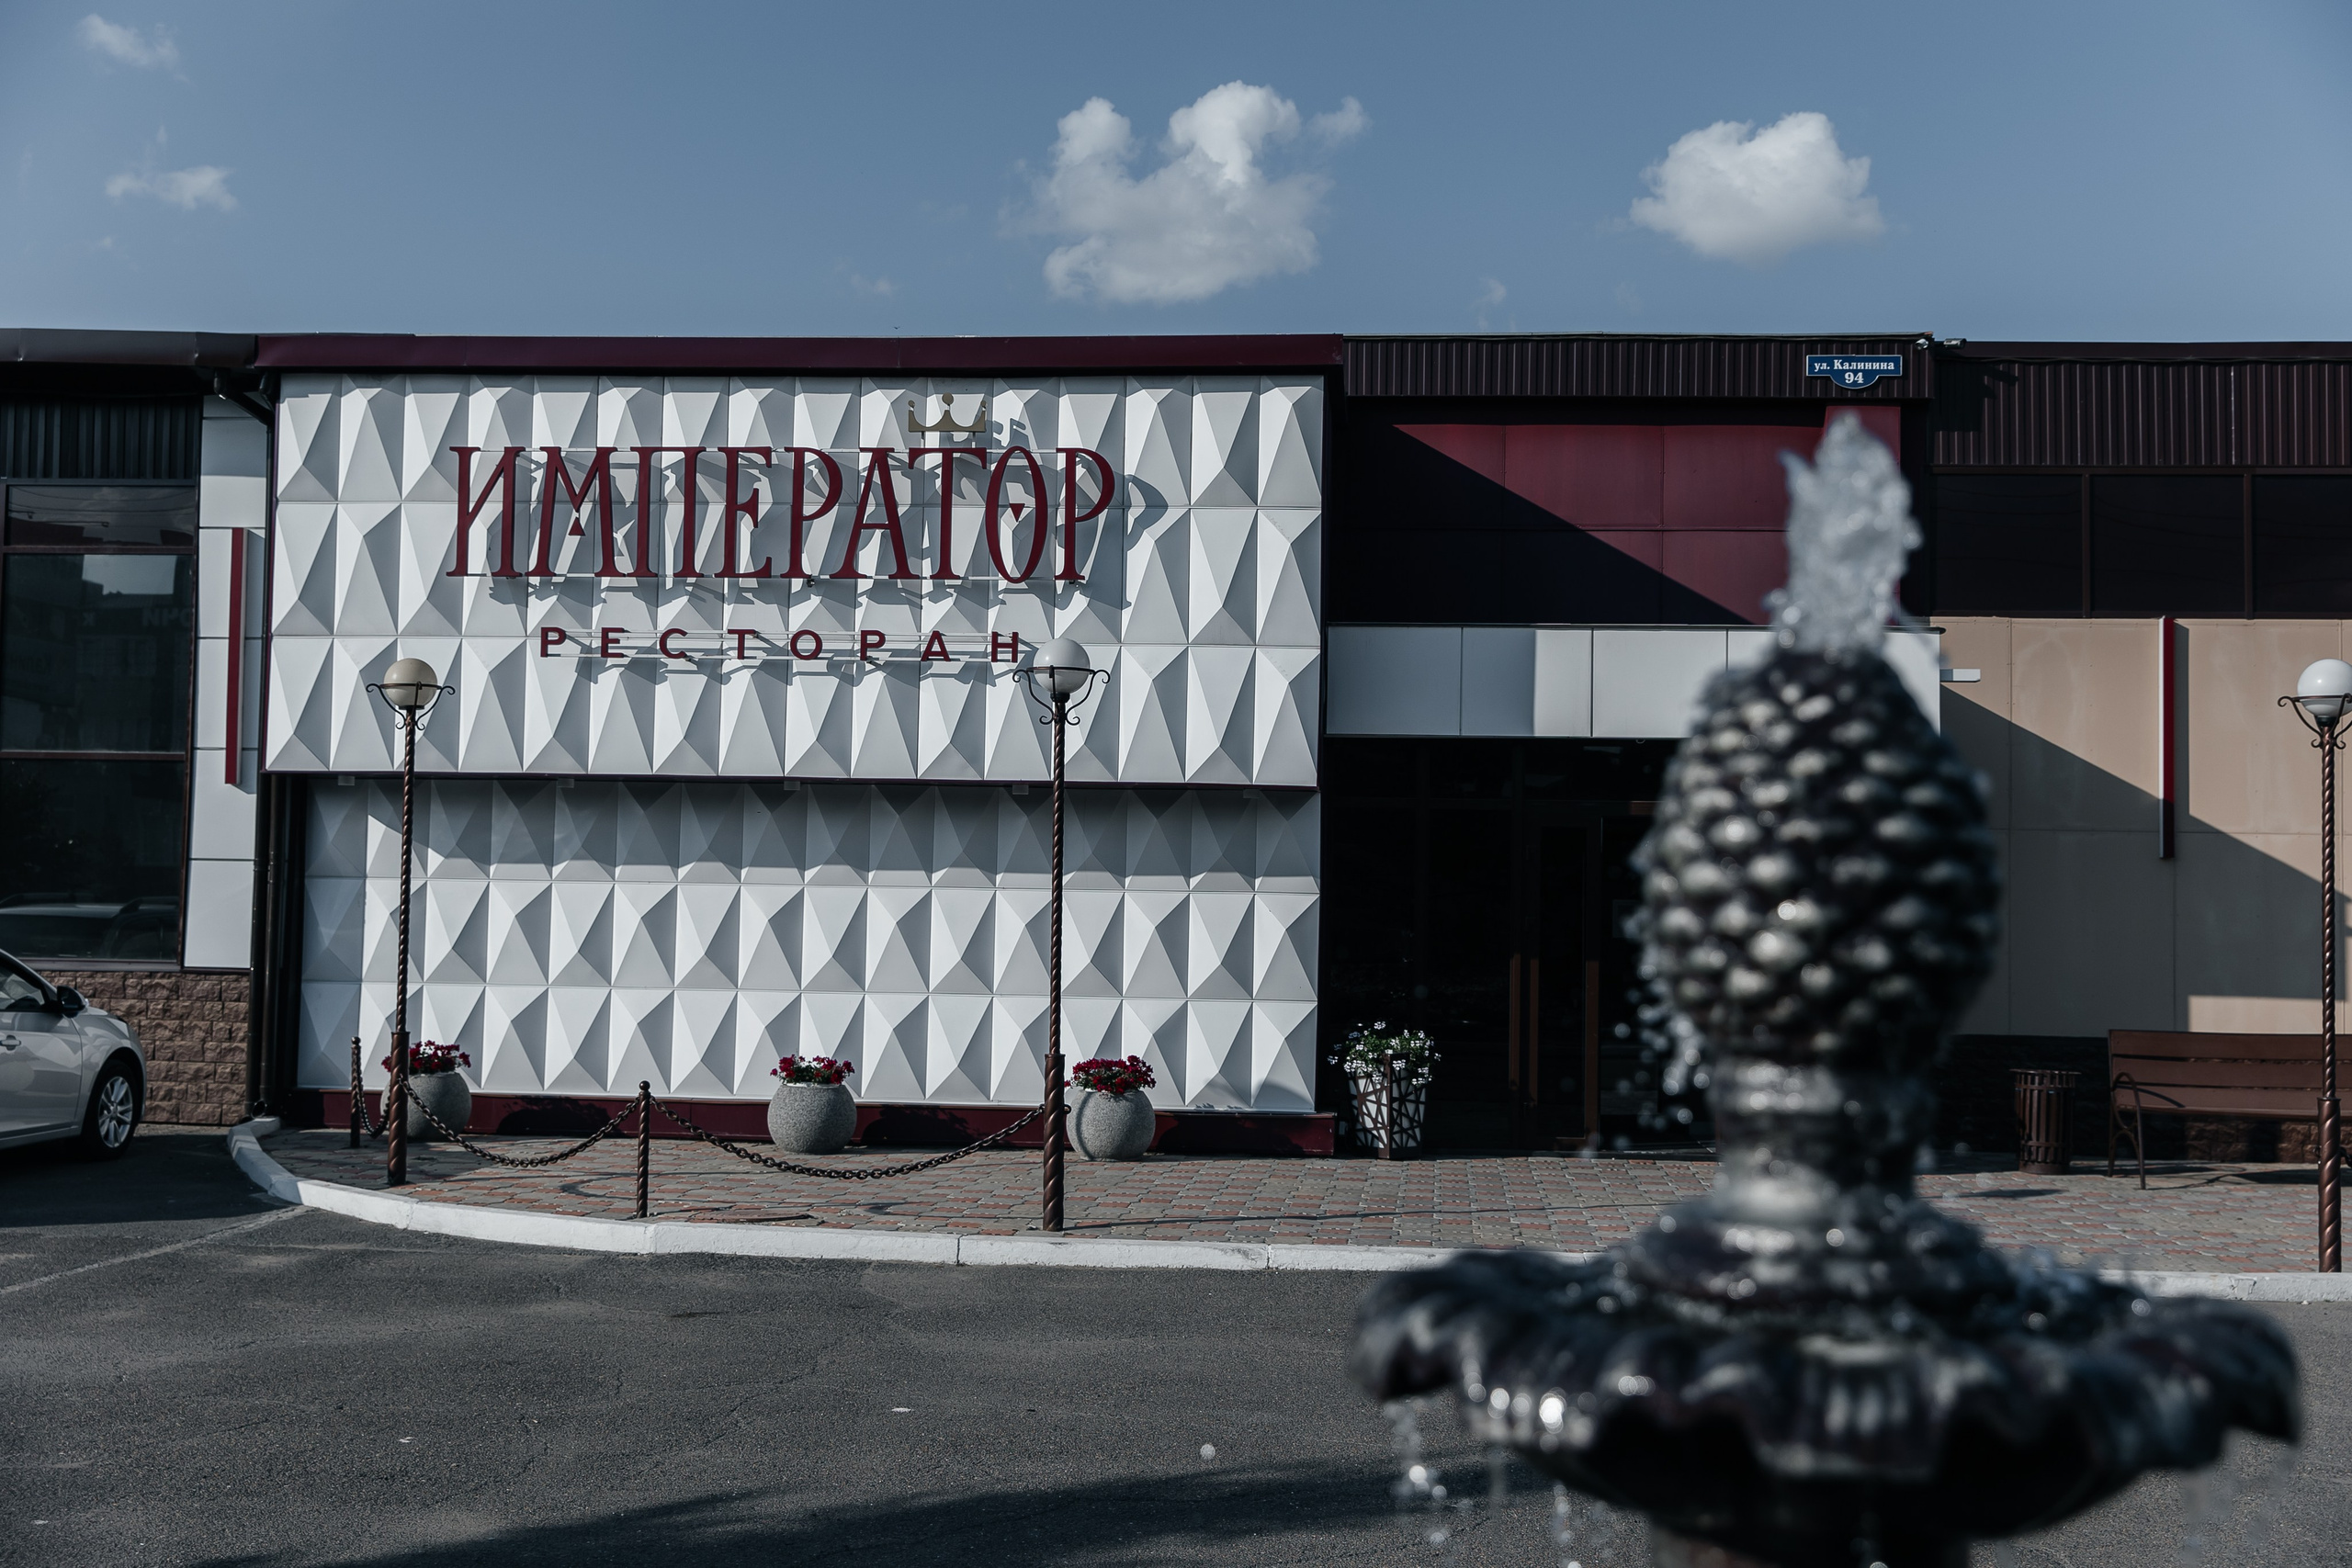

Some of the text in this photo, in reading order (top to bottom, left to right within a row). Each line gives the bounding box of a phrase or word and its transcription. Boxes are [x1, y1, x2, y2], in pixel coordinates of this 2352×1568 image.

[1814, 359, 1894, 372] ул. Калинина
[1844, 372, 1864, 384] 94
[446, 446, 1115, 583] ИМПЕРАТОР
[540, 626, 1018, 663] РЕСТОРАН
